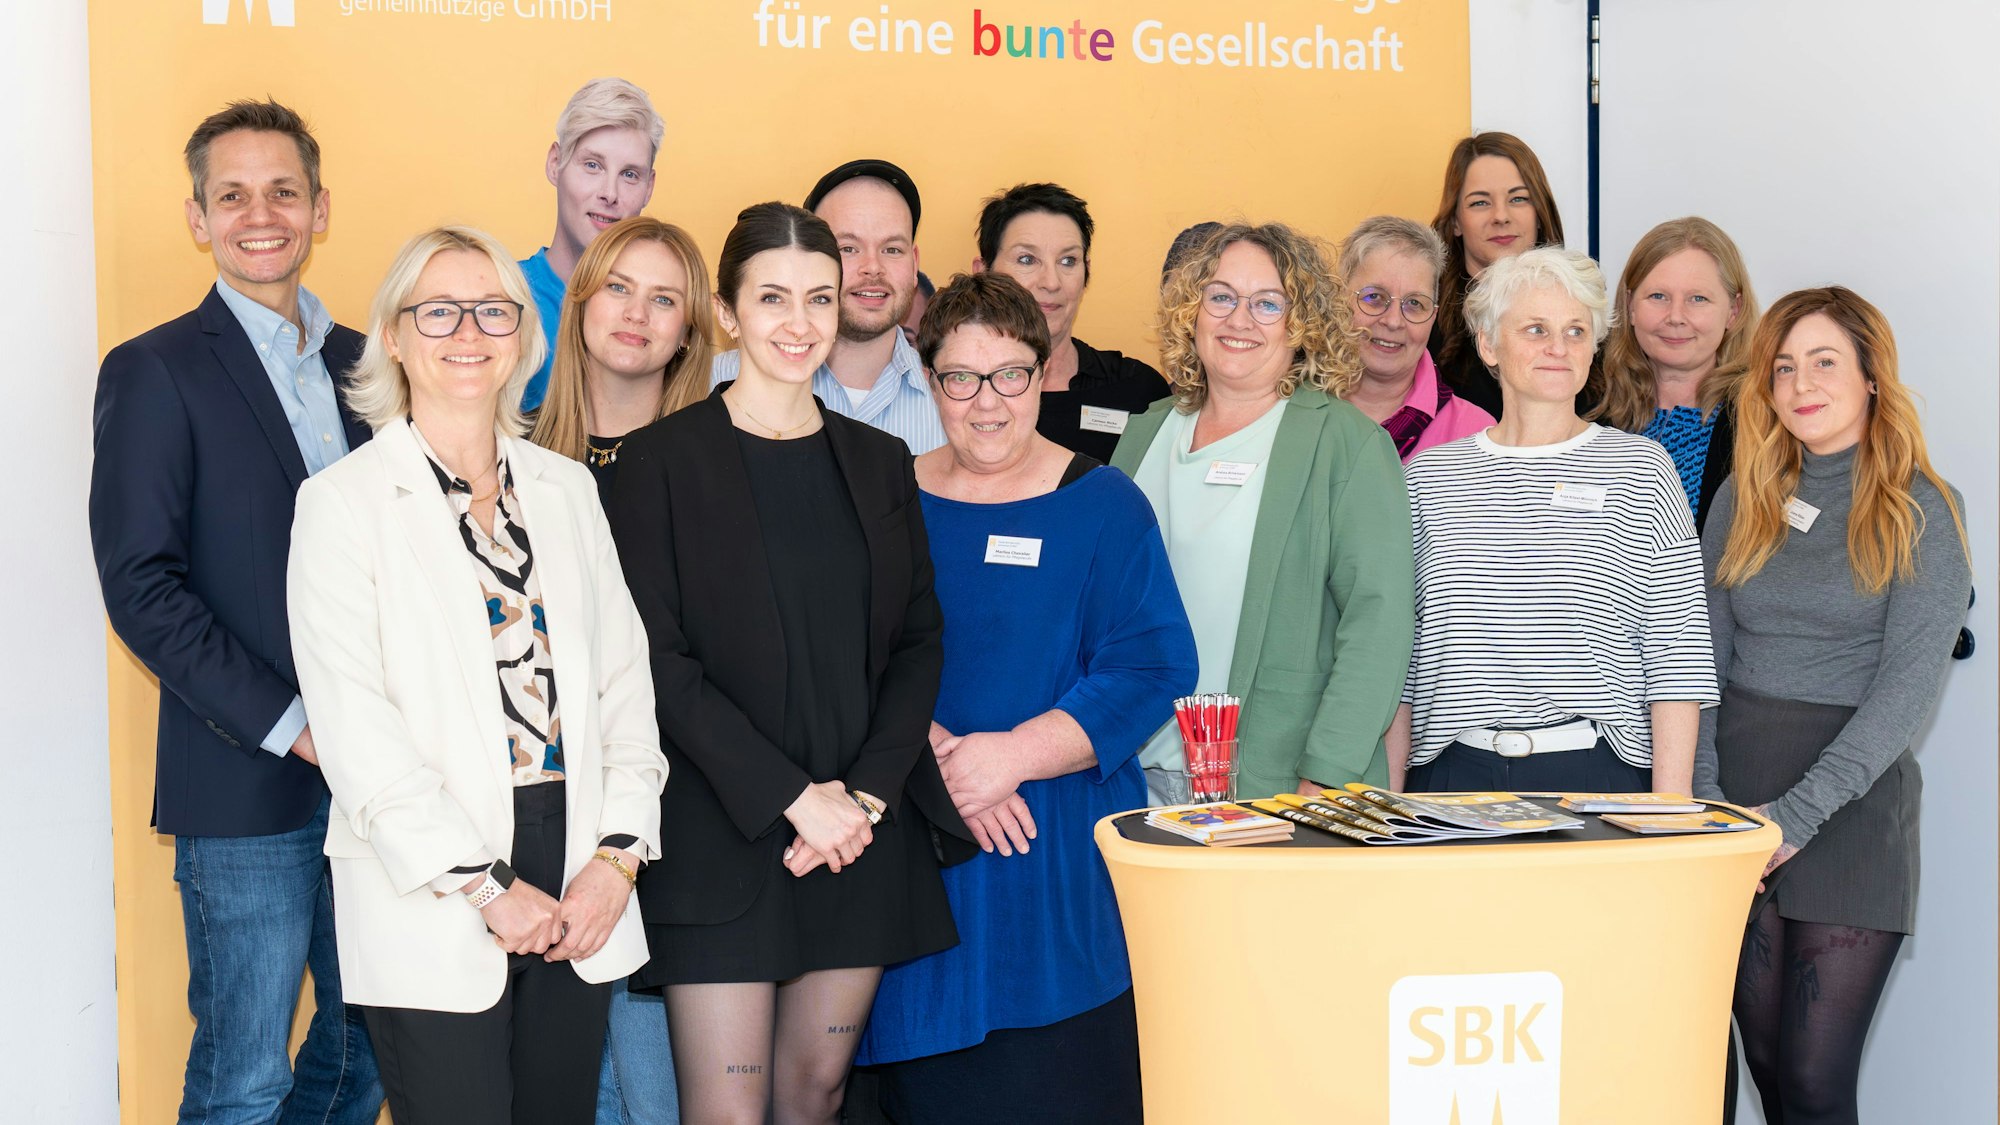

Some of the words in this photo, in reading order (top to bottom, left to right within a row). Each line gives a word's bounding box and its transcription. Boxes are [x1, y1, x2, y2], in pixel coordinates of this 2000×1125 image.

[513, 0, 611, 22] GmbH
[753, 0, 831, 49] für
[848, 4, 954, 54] eine
[973, 8, 1115, 62] bunte
[1131, 19, 1404, 72] Gesellschaft
[1407, 1002, 1547, 1067] SBK
[726, 1065, 763, 1074] NIGHT
